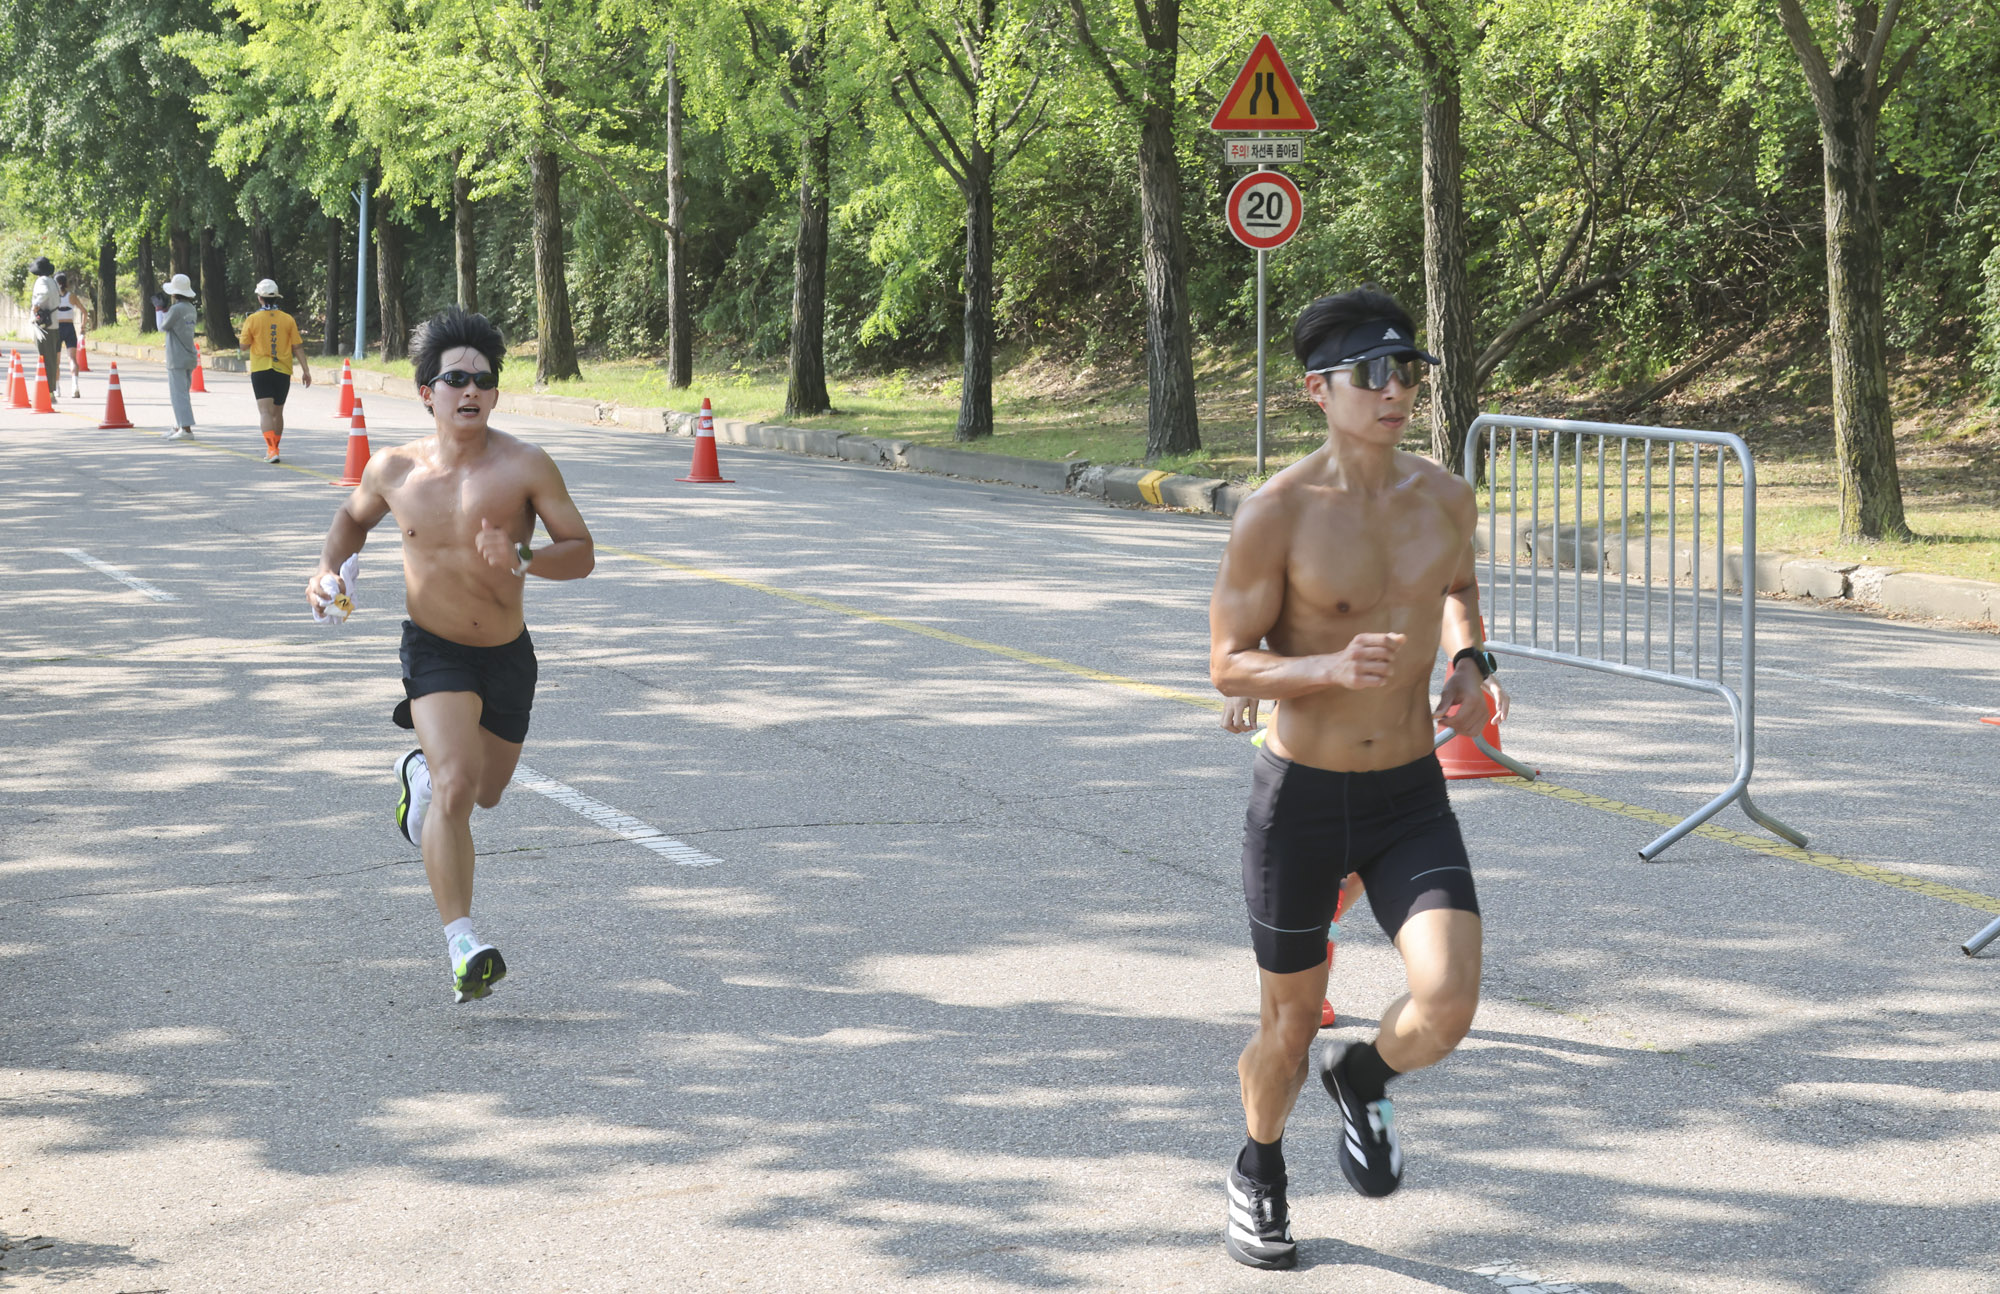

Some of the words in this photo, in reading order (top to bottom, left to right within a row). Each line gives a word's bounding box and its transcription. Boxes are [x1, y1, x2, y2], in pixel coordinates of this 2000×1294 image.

[1251, 144, 1274, 159] 차선폭
[1276, 144, 1299, 158] 좁아짐
[1246, 191, 1283, 220] 20
